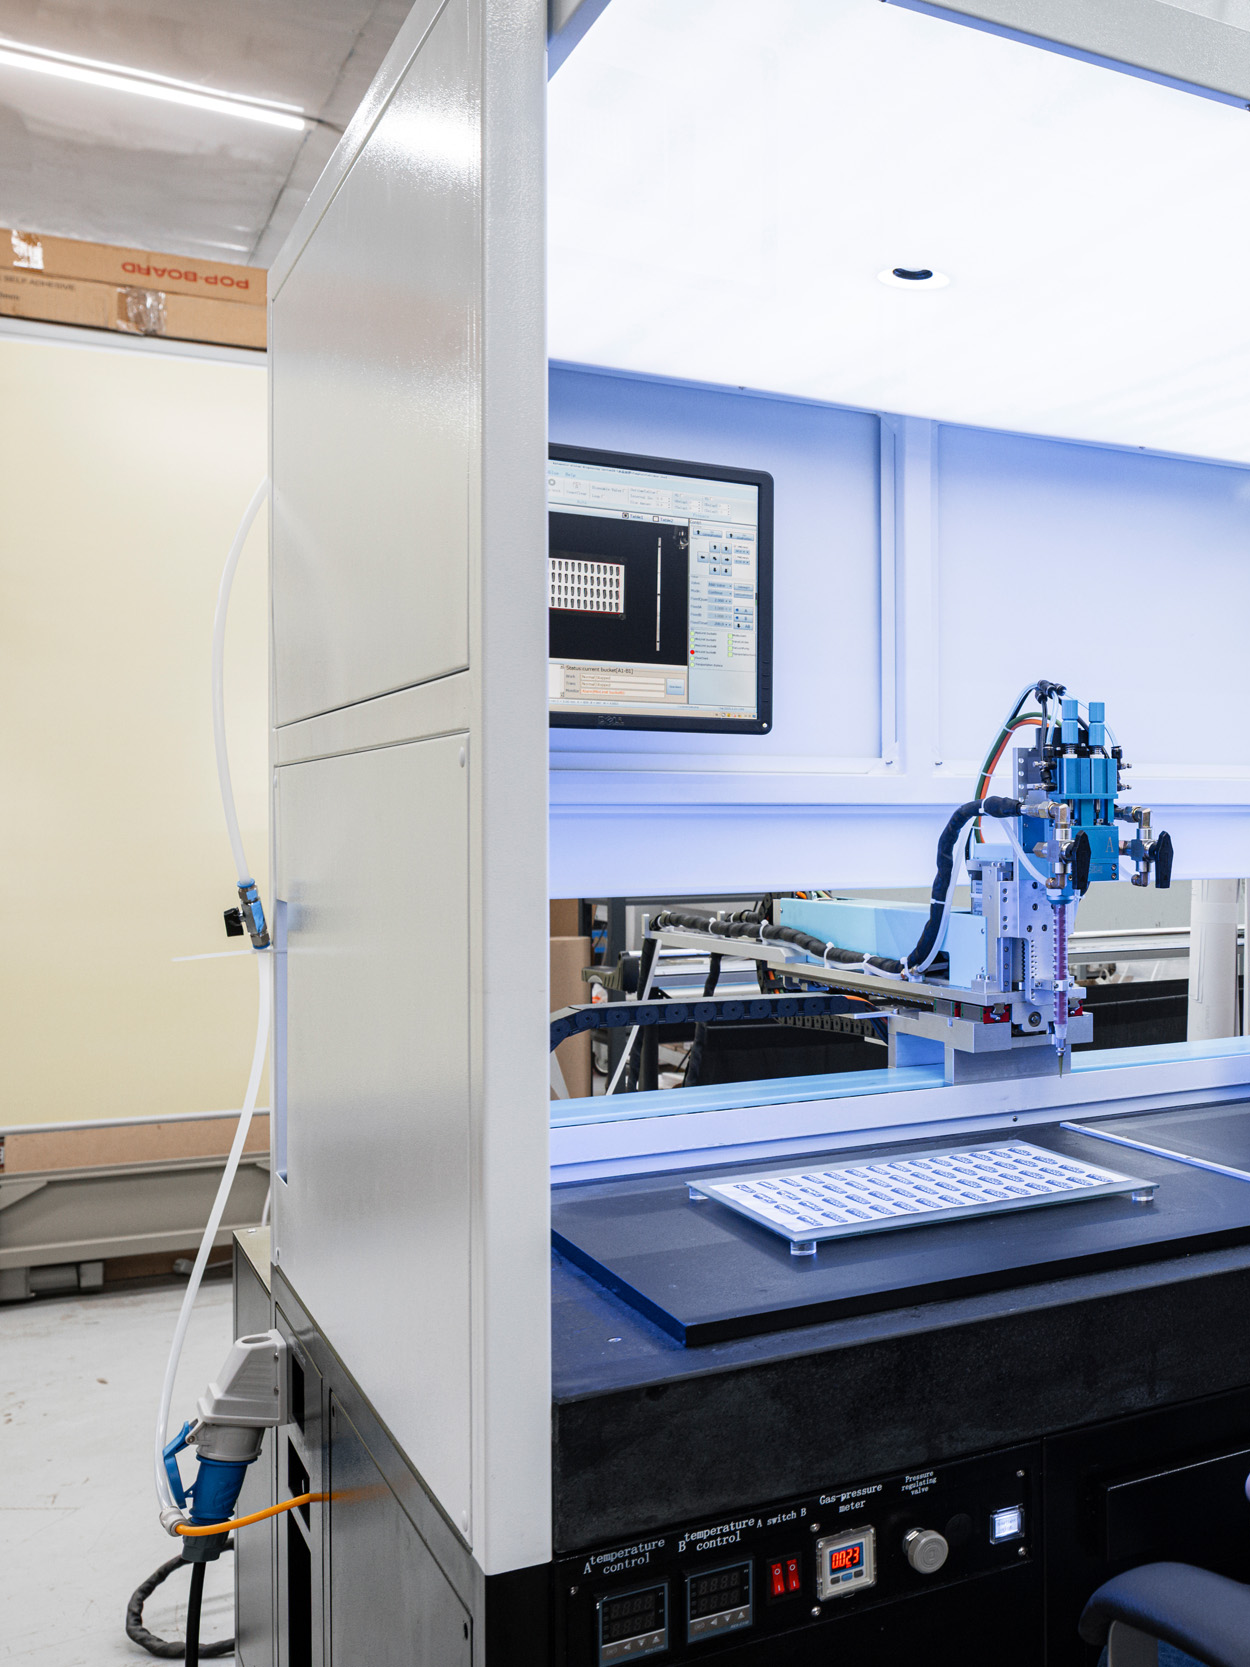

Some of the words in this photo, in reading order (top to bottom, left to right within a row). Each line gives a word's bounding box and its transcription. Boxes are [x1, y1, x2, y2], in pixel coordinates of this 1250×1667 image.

[1105, 836, 1114, 853] A
[901, 1476, 937, 1492] regulating
[905, 1471, 934, 1483] Pressure
[819, 1483, 883, 1506] Gas-pressure
[910, 1486, 929, 1496] valve
[838, 1500, 866, 1513] meter
[756, 1519, 763, 1529] A
[767, 1510, 797, 1526] switch
[800, 1507, 807, 1517] B
[678, 1540, 687, 1553] B
[684, 1518, 755, 1543] temperature
[696, 1530, 742, 1551] control
[583, 1562, 592, 1575] A
[590, 1538, 665, 1566] temperature
[603, 1552, 650, 1574] control
